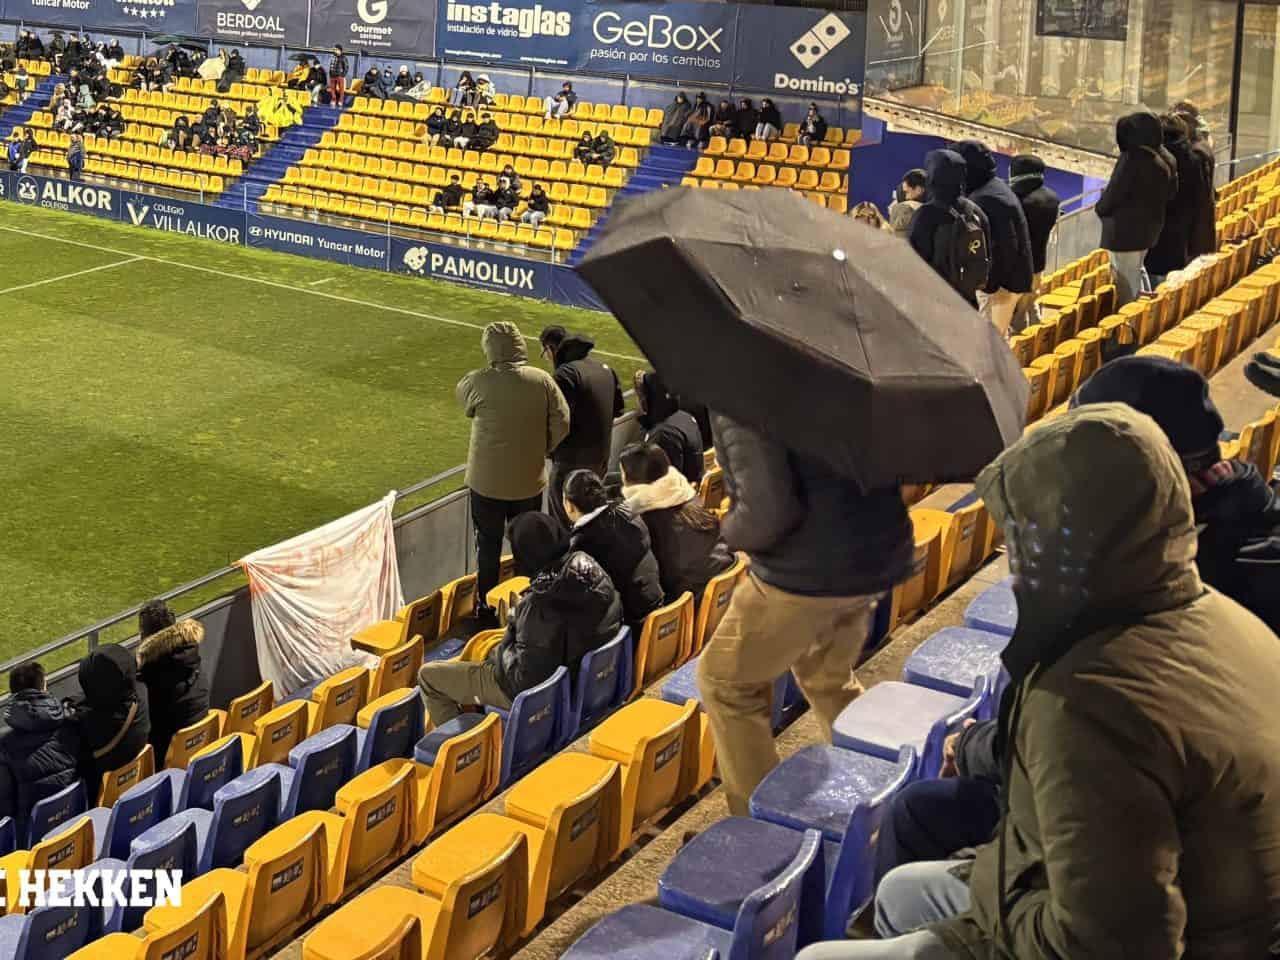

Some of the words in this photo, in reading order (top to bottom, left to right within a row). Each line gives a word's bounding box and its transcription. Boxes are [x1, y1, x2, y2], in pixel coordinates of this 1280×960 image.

[217, 12, 285, 32] BERDOAL
[446, 0, 571, 38] instaglas
[593, 11, 723, 53] GeBox
[590, 47, 626, 59] pasión
[629, 51, 649, 64] por
[652, 51, 669, 64] los
[672, 54, 721, 69] cambios
[774, 73, 859, 95] Domino's
[42, 181, 112, 210] ALKOR
[153, 203, 185, 215] COLEGIO
[153, 213, 240, 244] VILLALKOR
[264, 228, 313, 246] HYUNDAI
[318, 238, 352, 253] Yuncar
[354, 244, 385, 259] Motor
[431, 253, 534, 290] PAMOLUX
